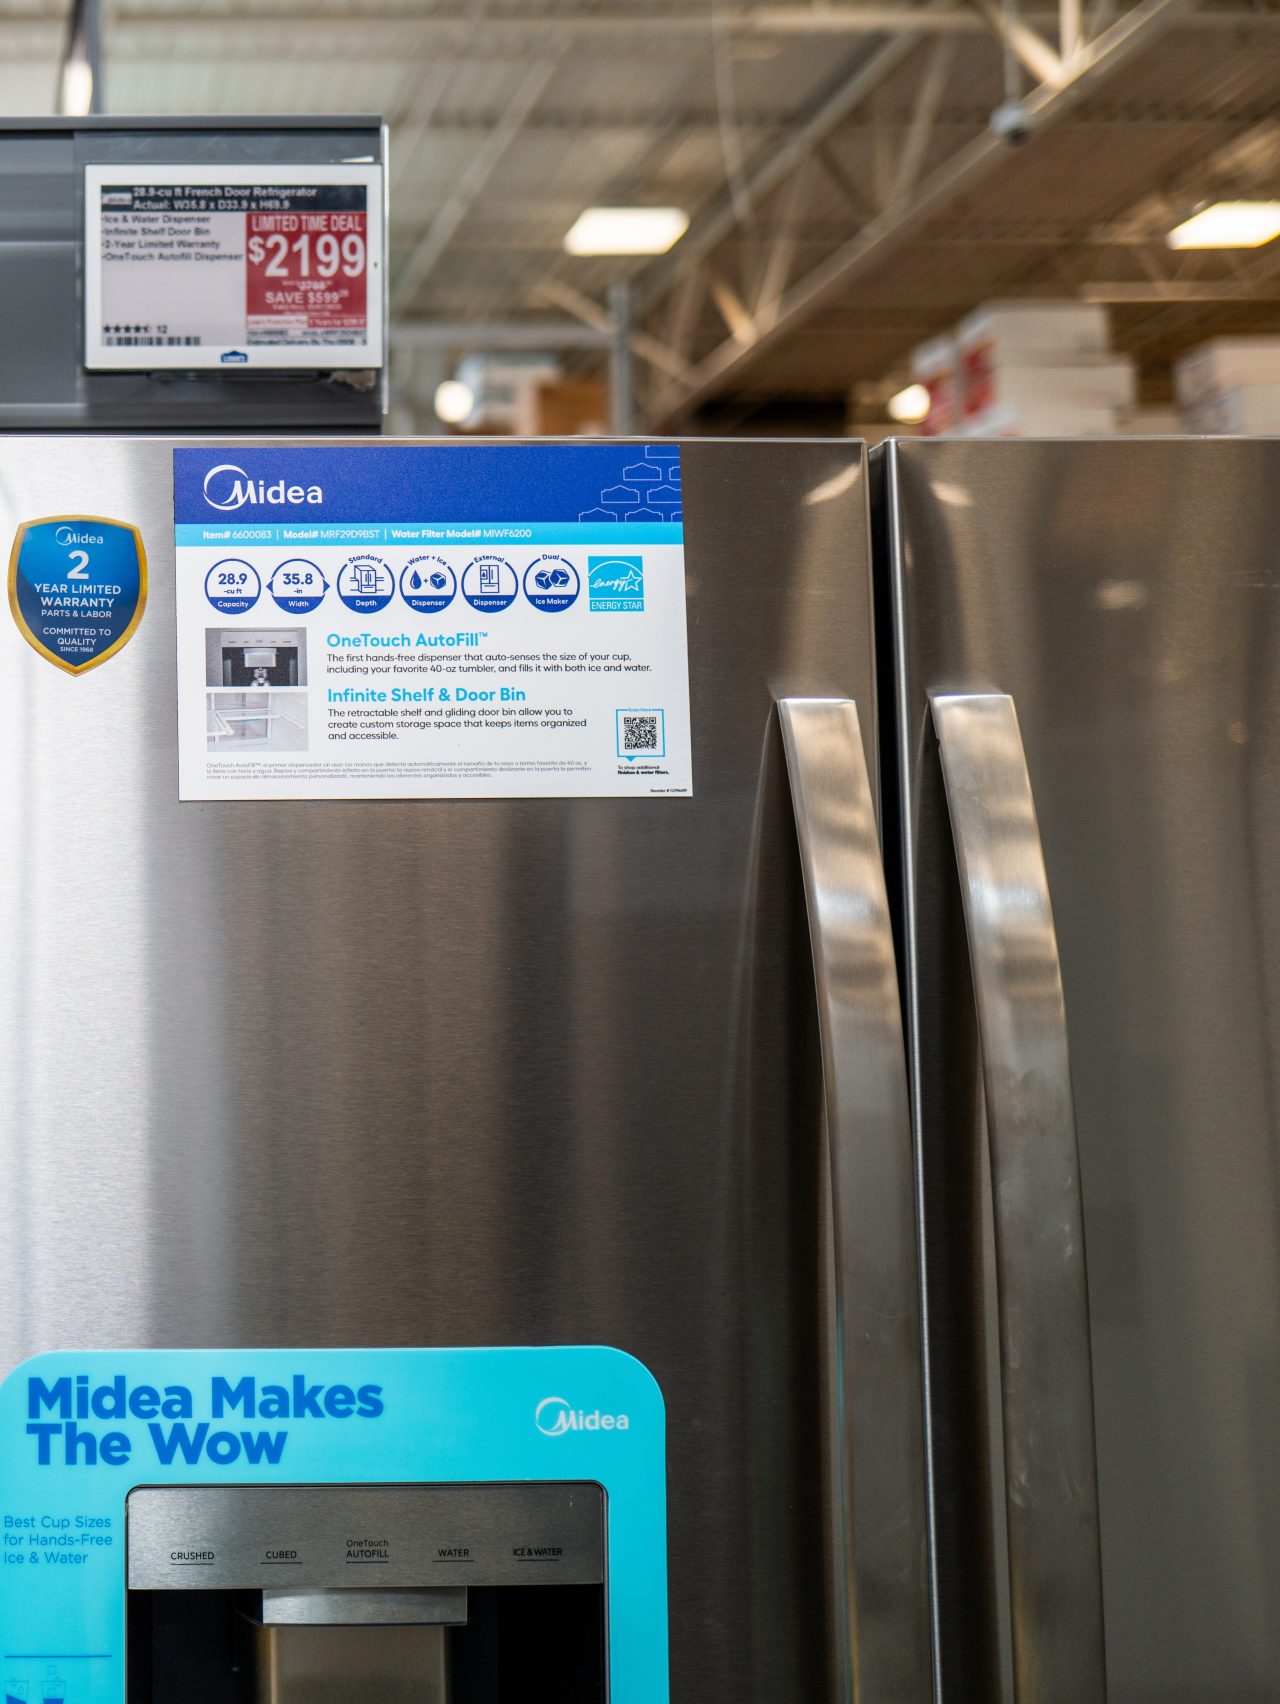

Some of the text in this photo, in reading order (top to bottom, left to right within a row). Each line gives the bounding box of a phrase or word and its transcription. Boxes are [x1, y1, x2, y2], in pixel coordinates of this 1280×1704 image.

[133, 201, 171, 209] Actual:
[252, 215, 362, 231] LIMITED TIME DEAL
[248, 234, 365, 277] $2199
[265, 291, 304, 303] SAVE
[203, 480, 323, 510] Midea
[56, 533, 104, 546] Midea
[203, 529, 531, 539] Item# 6600083 Model# MRF29D9BST Water Filter Model# MIWF6200
[348, 554, 383, 564] Standard
[407, 554, 448, 566] Water Ice
[473, 554, 505, 564] External
[67, 550, 89, 580] 2
[218, 573, 247, 585] 28.9
[282, 573, 313, 585] 35.8
[34, 583, 121, 594] YEAR LIMITED
[40, 596, 114, 607] WARRANTY
[218, 600, 248, 609] Capacity
[356, 599, 377, 608] Depth
[411, 599, 445, 607] Dispenser
[473, 599, 507, 607] Dispenser
[592, 601, 642, 610] ENERGY STAR
[72, 609, 78, 617] &
[42, 627, 111, 636] COMMITTED TO
[57, 638, 97, 647] QUALITY
[326, 632, 410, 647] OneTouch
[326, 652, 631, 663] The first hands-free dispenser that auto-senses the size of your cup,
[326, 665, 368, 675] including
[370, 666, 390, 674] your
[393, 664, 427, 672] favorite
[430, 664, 456, 672] 40-oz
[458, 664, 495, 673] tumbler,
[498, 664, 516, 672] and
[518, 663, 533, 672] fills
[535, 663, 541, 671] it
[543, 663, 562, 671] with
[564, 663, 586, 672] both
[588, 663, 601, 671] ice
[603, 663, 621, 671] and
[328, 686, 525, 702] Infinite Shelf & Door Bin
[327, 708, 345, 717] The
[347, 708, 398, 716] retractable
[400, 708, 422, 716] shelf
[424, 708, 442, 716] and
[444, 707, 475, 718] gliding
[477, 708, 499, 716] door
[501, 707, 516, 715] bin
[518, 707, 542, 715] allow
[544, 709, 561, 717] you
[359, 720, 393, 728] custom
[396, 720, 431, 729] storage
[433, 721, 461, 729] space
[463, 719, 483, 727] that
[485, 719, 512, 728] keeps
[513, 719, 538, 727] items
[540, 718, 586, 728] organized
[327, 731, 398, 740] and accessible.
[27, 1375, 384, 1420] Midea Makes
[535, 1410, 628, 1436] Midea
[26, 1424, 288, 1466] The Wow
[3, 1515, 111, 1530] Best Cup Sizes
[3, 1532, 112, 1546] for Hands-Free
[346, 1539, 389, 1547] OneTouch
[4, 1551, 88, 1564] Ice & Water
[170, 1552, 215, 1560] CRUSHED
[265, 1550, 297, 1559] CUBED
[346, 1550, 389, 1558] AUTOFILL
[438, 1548, 469, 1557] WATER
